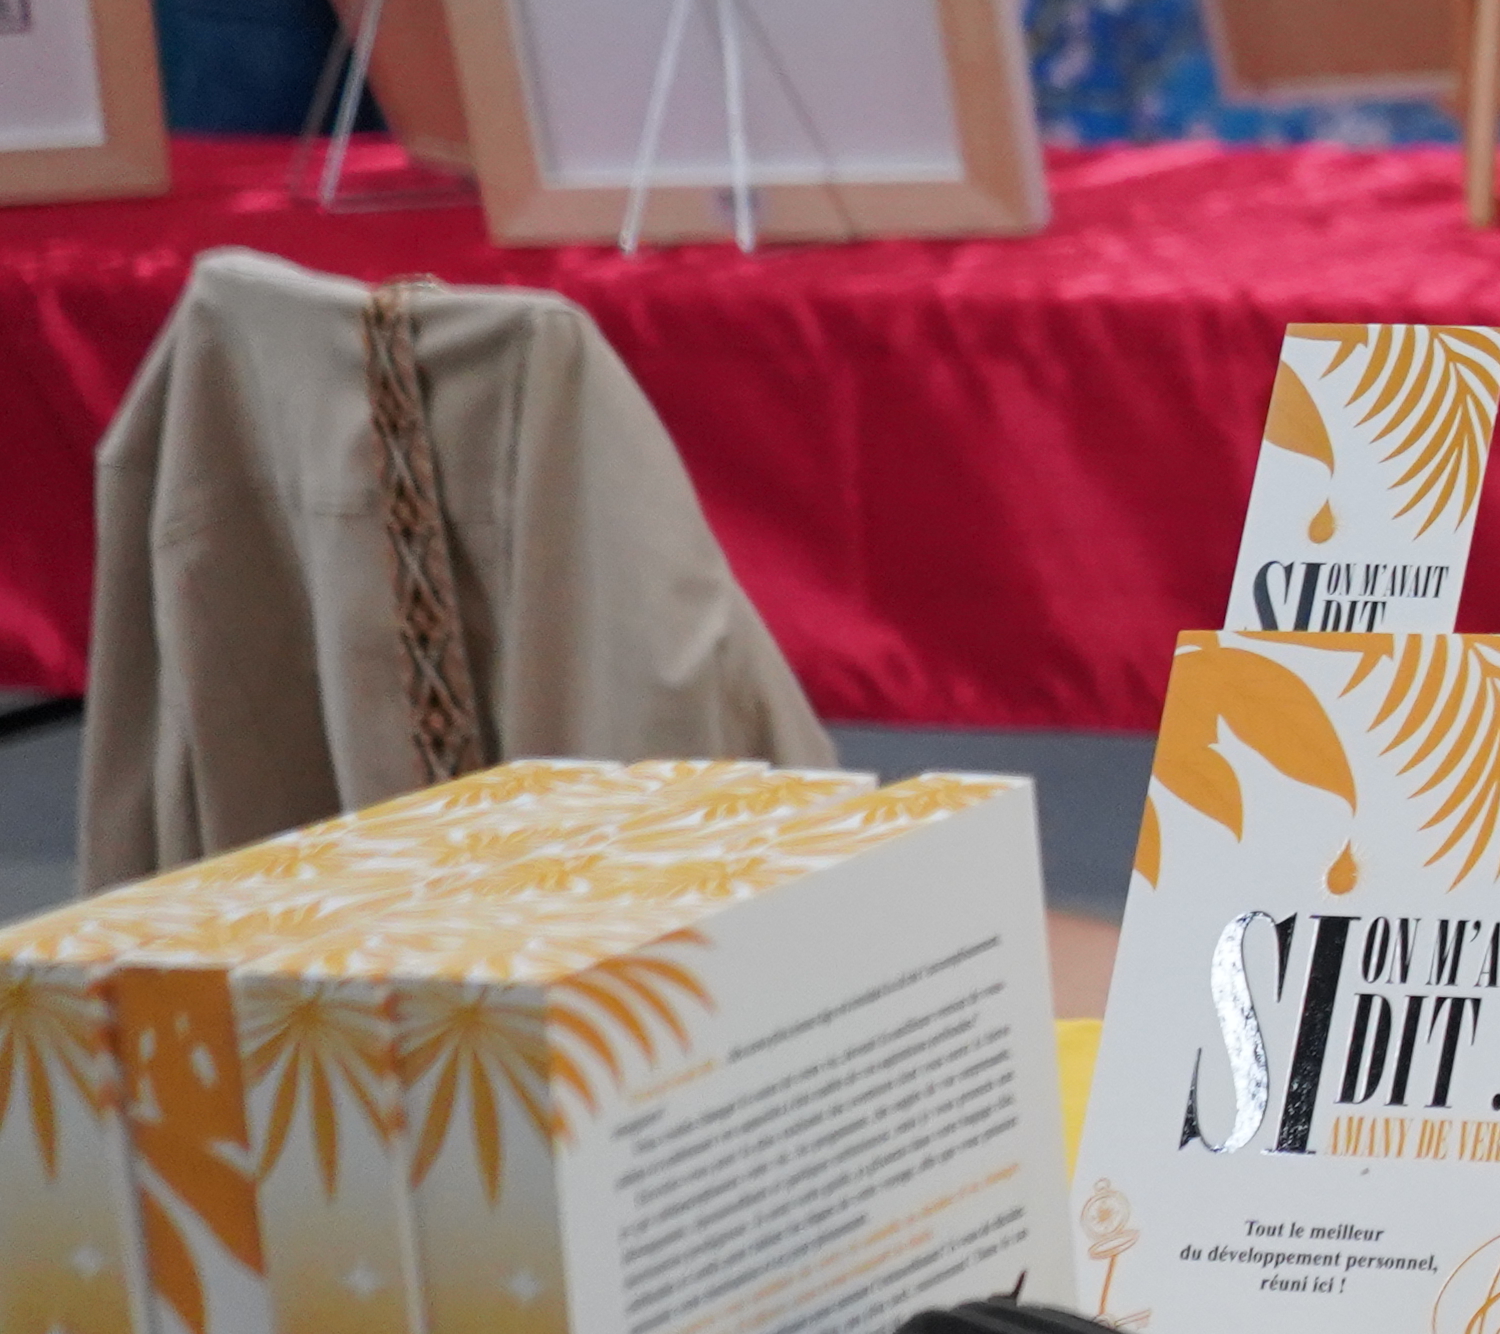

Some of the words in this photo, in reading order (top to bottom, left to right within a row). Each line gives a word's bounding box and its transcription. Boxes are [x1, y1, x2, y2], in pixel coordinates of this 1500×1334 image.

[1326, 562, 1358, 597] ON
[1360, 917, 1422, 986] ON
[1333, 993, 1482, 1110] DIT
[1326, 1116, 1413, 1158] AMANY
[1415, 1119, 1450, 1161] DE
[1245, 1219, 1284, 1238] Tout
[1289, 1222, 1304, 1239] le
[1309, 1223, 1385, 1242] meilleur
[1179, 1244, 1202, 1261] du
[1207, 1244, 1343, 1269] développement
[1345, 1254, 1439, 1274] personnel,
[1259, 1273, 1308, 1292] réuni
[1312, 1276, 1334, 1294] ici
